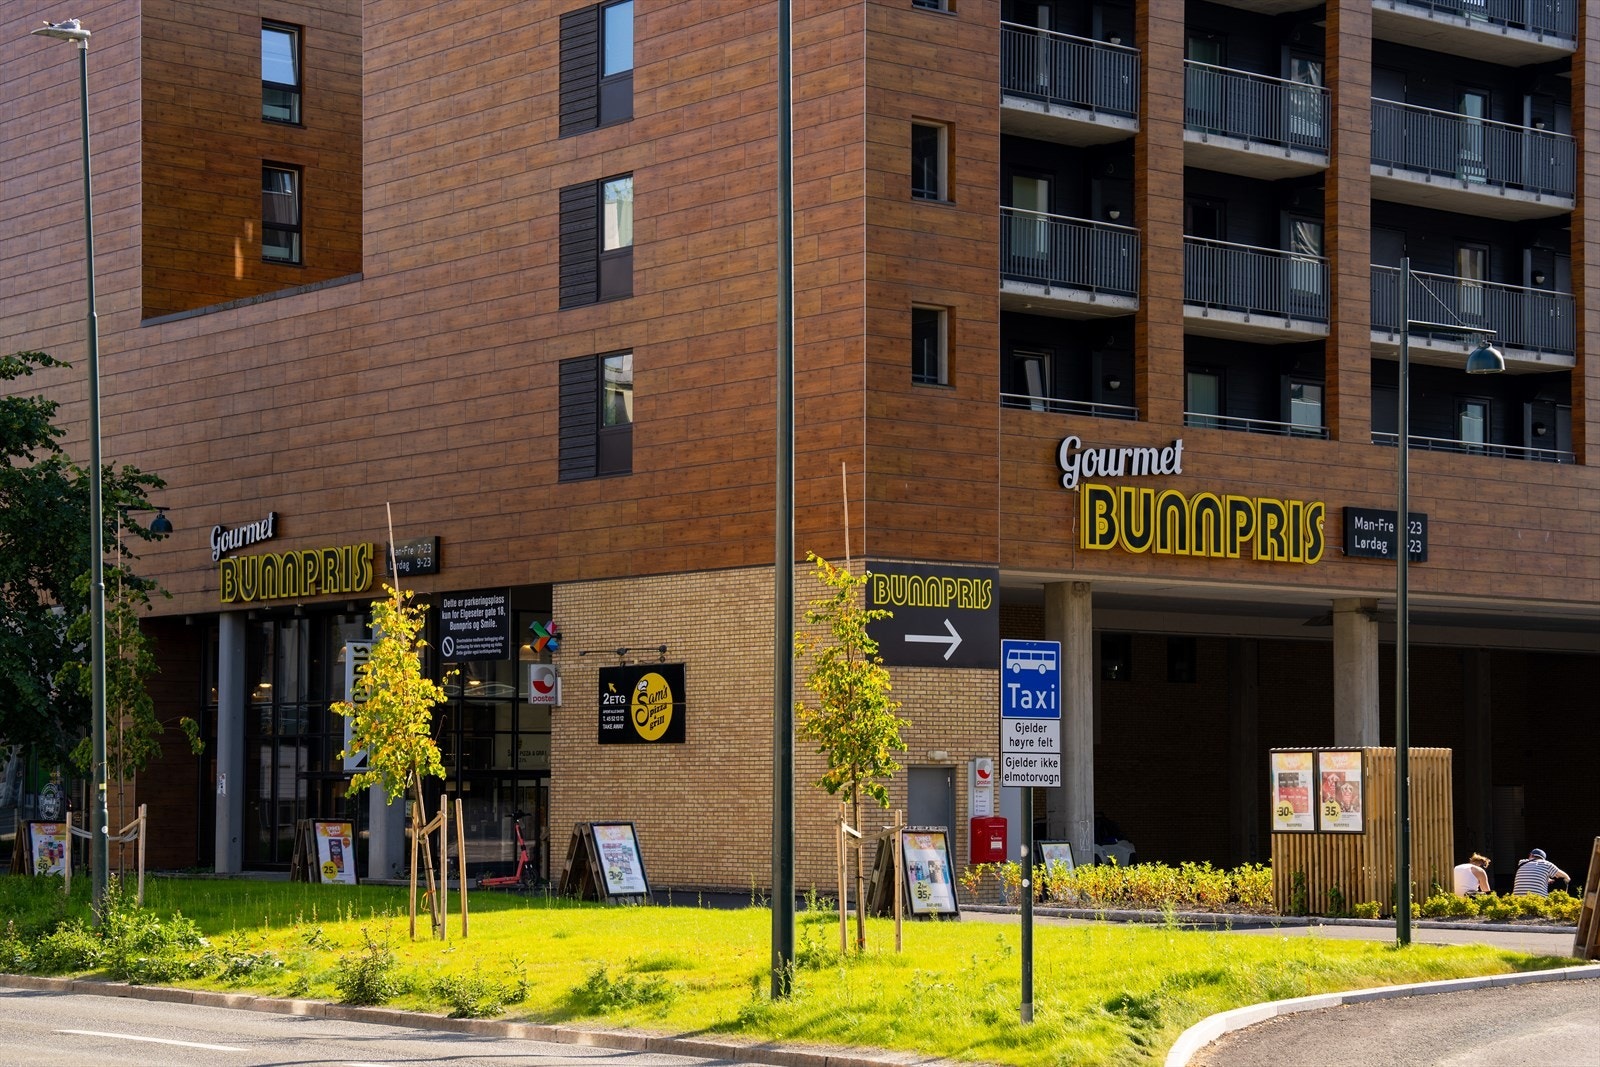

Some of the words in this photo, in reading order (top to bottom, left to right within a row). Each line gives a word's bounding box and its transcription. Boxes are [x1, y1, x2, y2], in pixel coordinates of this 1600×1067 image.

[1059, 435, 1184, 489] Gourmet
[1080, 482, 1325, 565] BUNNPRIS
[1354, 516, 1394, 533] Man-Fre
[210, 511, 274, 562] Gourmet
[390, 545, 414, 557] an-Fre
[417, 543, 432, 554] 7-23
[1354, 535, 1388, 554] Lørdag
[390, 560, 410, 572] Lrdag
[417, 557, 432, 568] 9-23
[220, 542, 374, 603] BUNNPRIS
[873, 573, 992, 610] BUNNPRIS
[444, 599, 457, 608] Dette
[458, 599, 464, 607] er
[464, 595, 504, 608] parkeringsplass
[441, 610, 451, 620] kun
[485, 607, 496, 619] gate
[450, 620, 472, 631] Bunnpris
[473, 621, 480, 630] og
[602, 692, 626, 705] 2ETG
[1008, 683, 1055, 709] Taxi
[649, 703, 667, 718] pizza
[649, 715, 665, 731] grill
[1015, 722, 1048, 735] Gjelder
[1009, 737, 1034, 750] høyre
[1037, 737, 1054, 748] felt
[1005, 757, 1037, 770] Gjelder
[1040, 758, 1058, 768] ikke
[1004, 771, 1060, 785] elmotorvogn
